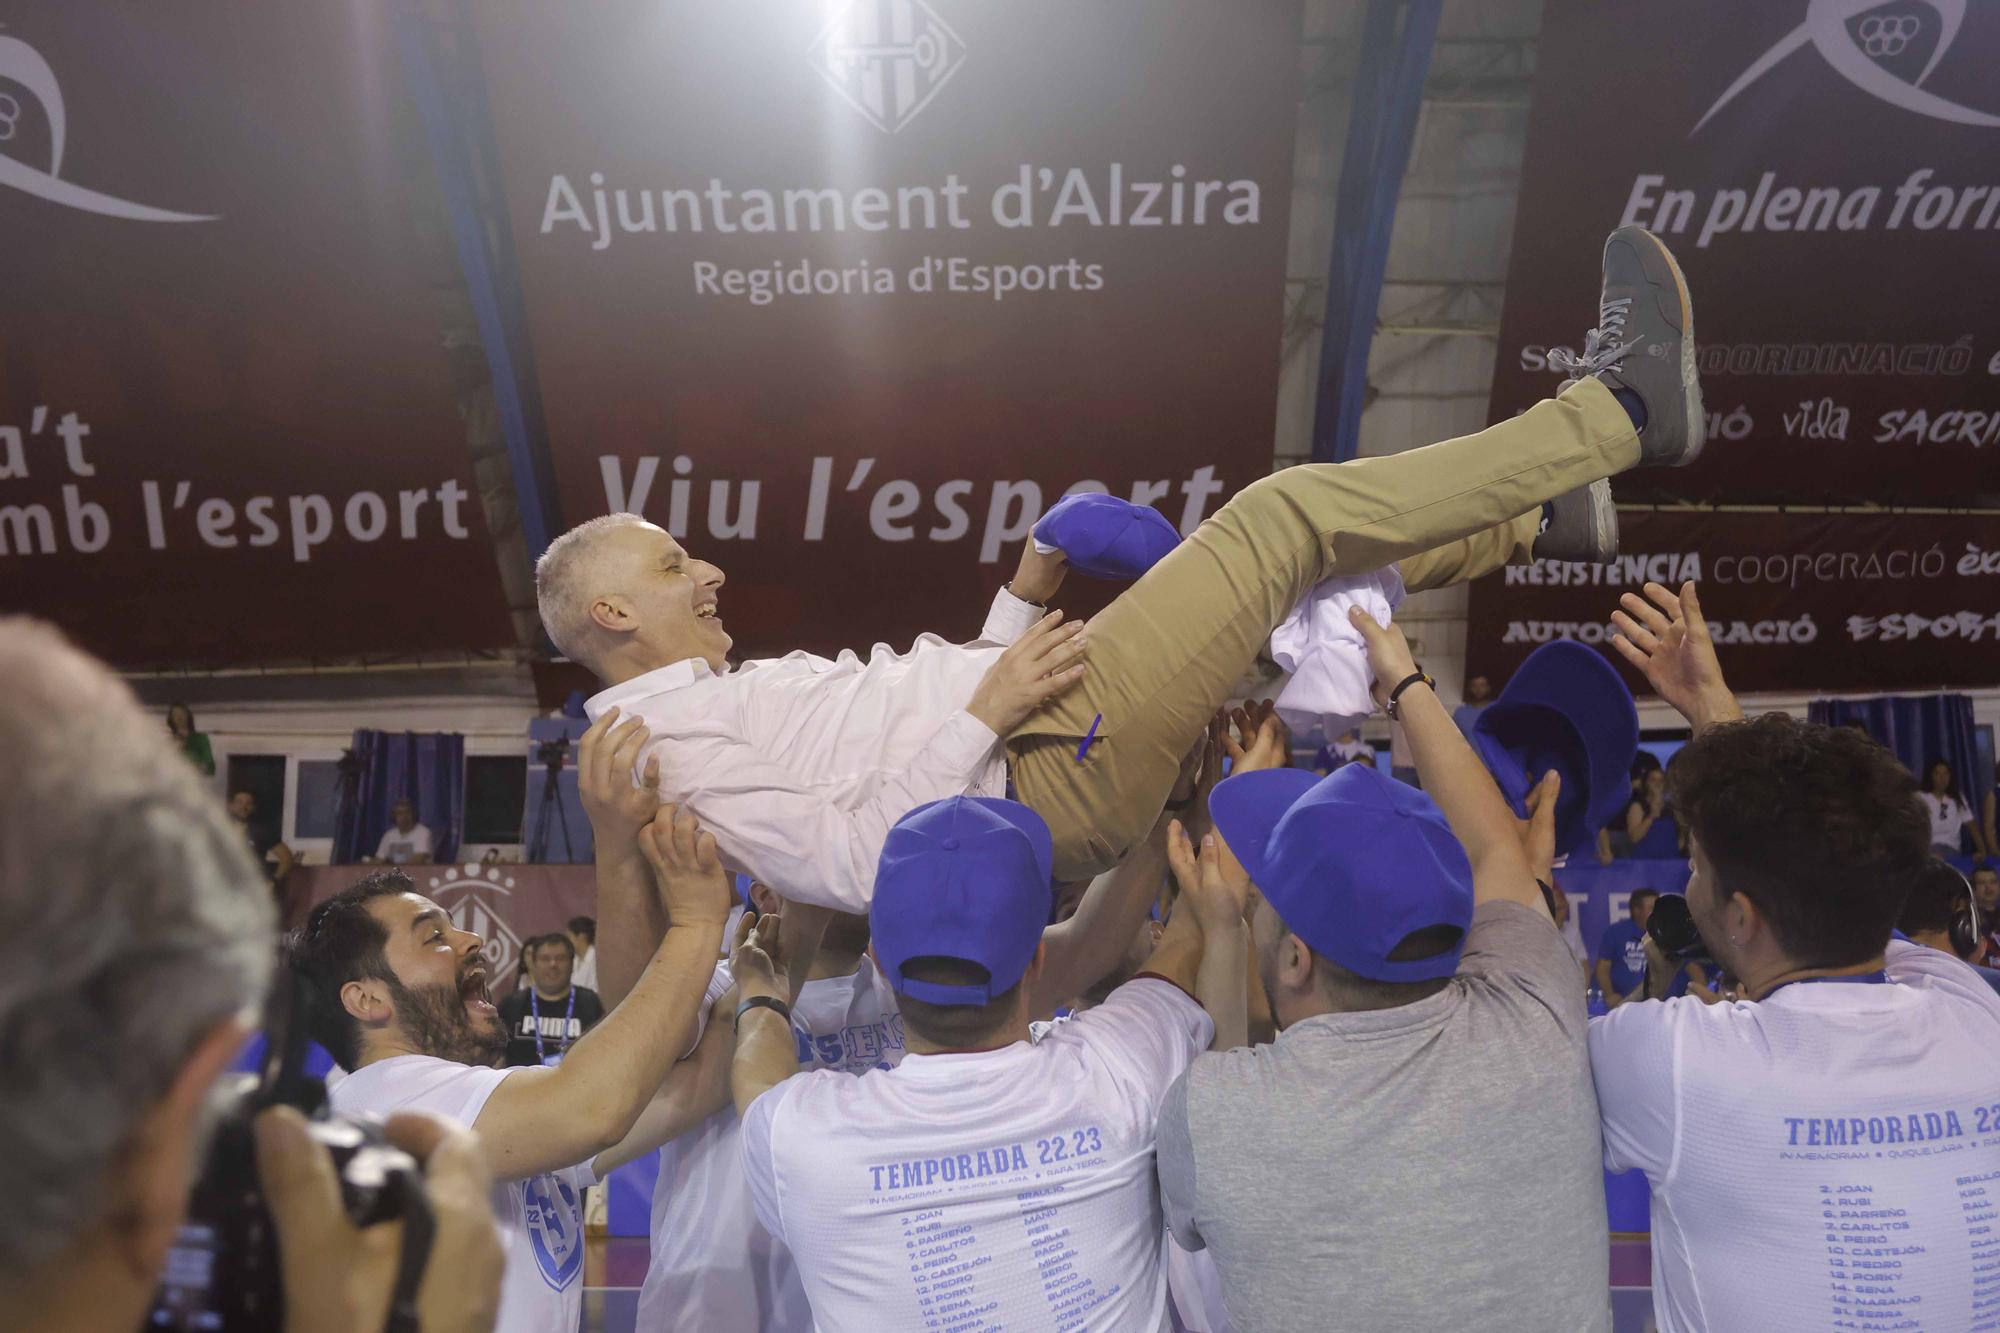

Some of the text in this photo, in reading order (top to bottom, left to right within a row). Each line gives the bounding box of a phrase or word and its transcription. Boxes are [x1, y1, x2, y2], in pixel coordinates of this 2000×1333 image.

[539, 164, 1261, 250] Ajuntament d'Alzira
[1619, 174, 1697, 234] En
[1695, 171, 1880, 248] plena
[694, 256, 1105, 305] Regidoria d'Esports
[1782, 398, 1848, 440] vida
[599, 455, 760, 541] Viu
[142, 478, 469, 562] l'esport
[1784, 1110, 1963, 1145] TEMPORADA
[869, 1127, 1102, 1191] TEMPORADA 22.23
[1836, 1185, 1873, 1193] JOAN
[914, 1209, 943, 1223] JOAN
[1840, 1221, 1910, 1231] CARLITOS
[919, 1236, 976, 1258] CARLITOS
[1034, 1241, 1064, 1258] PACO
[933, 1274, 973, 1291] PEDRO
[943, 1302, 998, 1325] NARANJO
